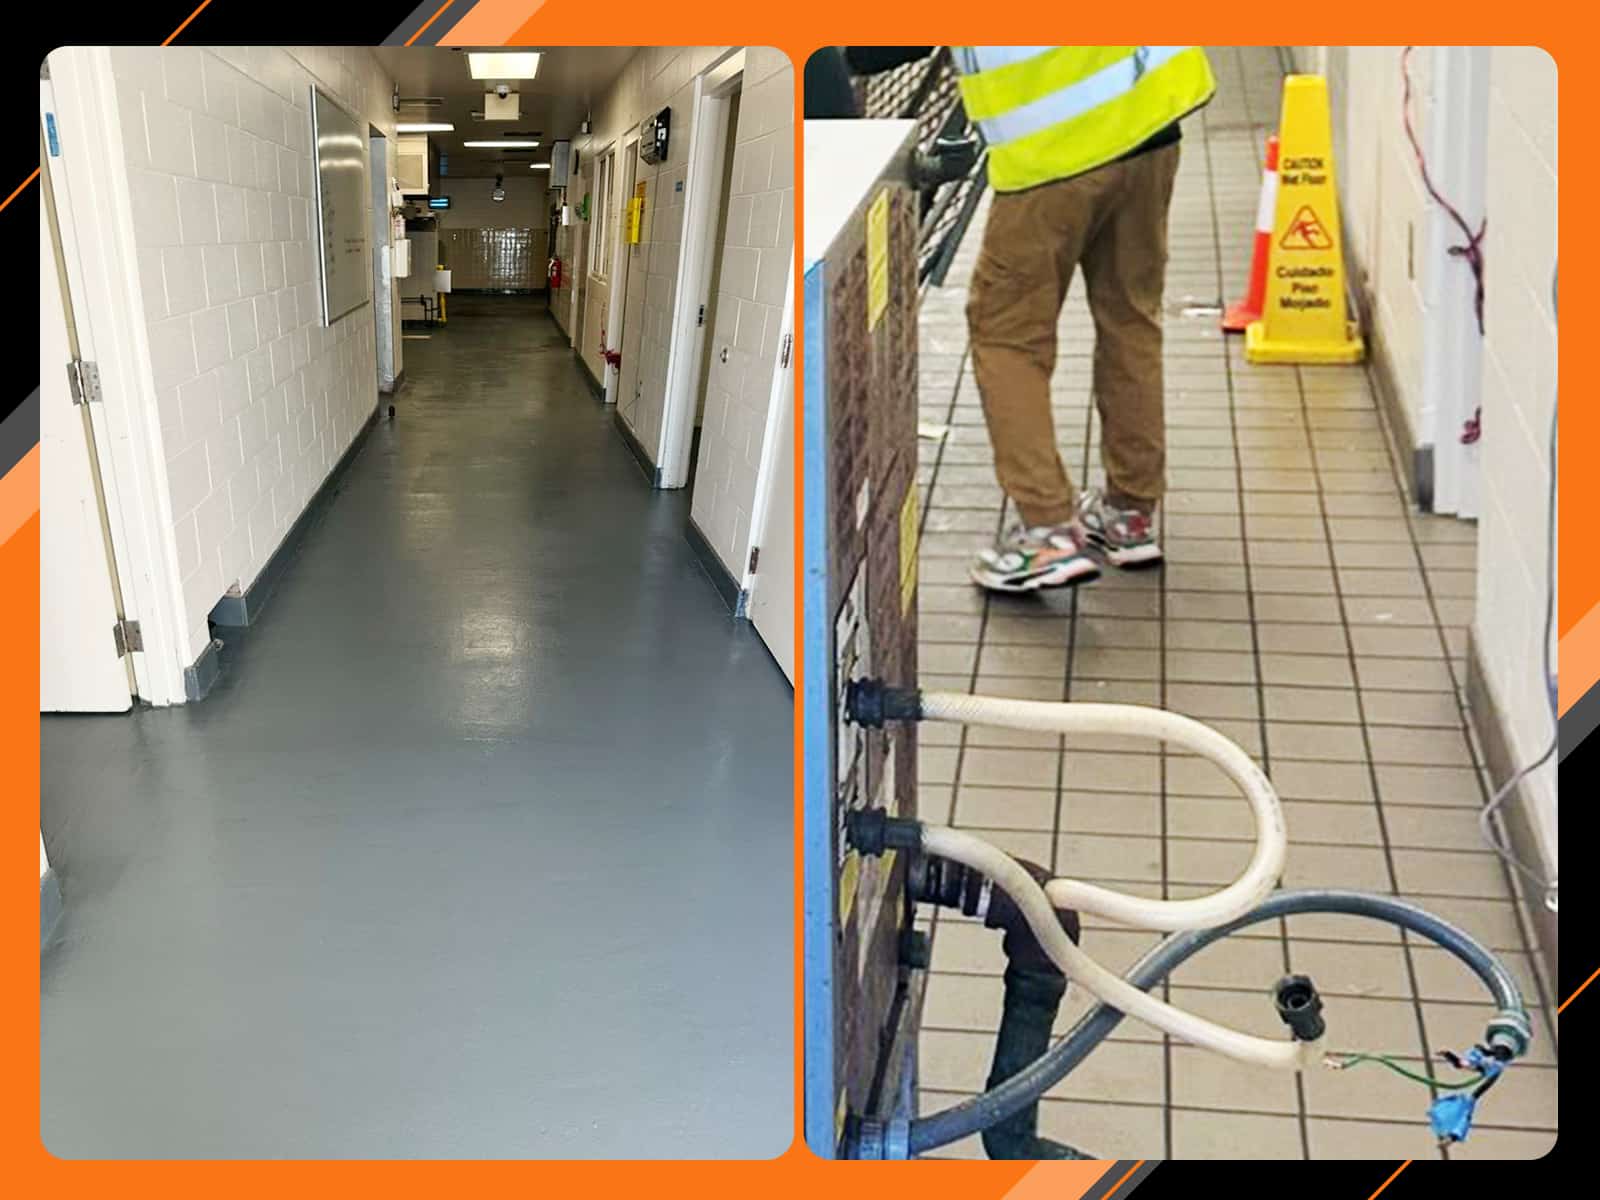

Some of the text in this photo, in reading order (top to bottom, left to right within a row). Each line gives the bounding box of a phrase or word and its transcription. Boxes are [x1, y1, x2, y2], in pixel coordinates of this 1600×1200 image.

[1276, 265, 1334, 278] Cuidado
[1291, 282, 1318, 294] Piso
[1280, 298, 1331, 312] Mojado
